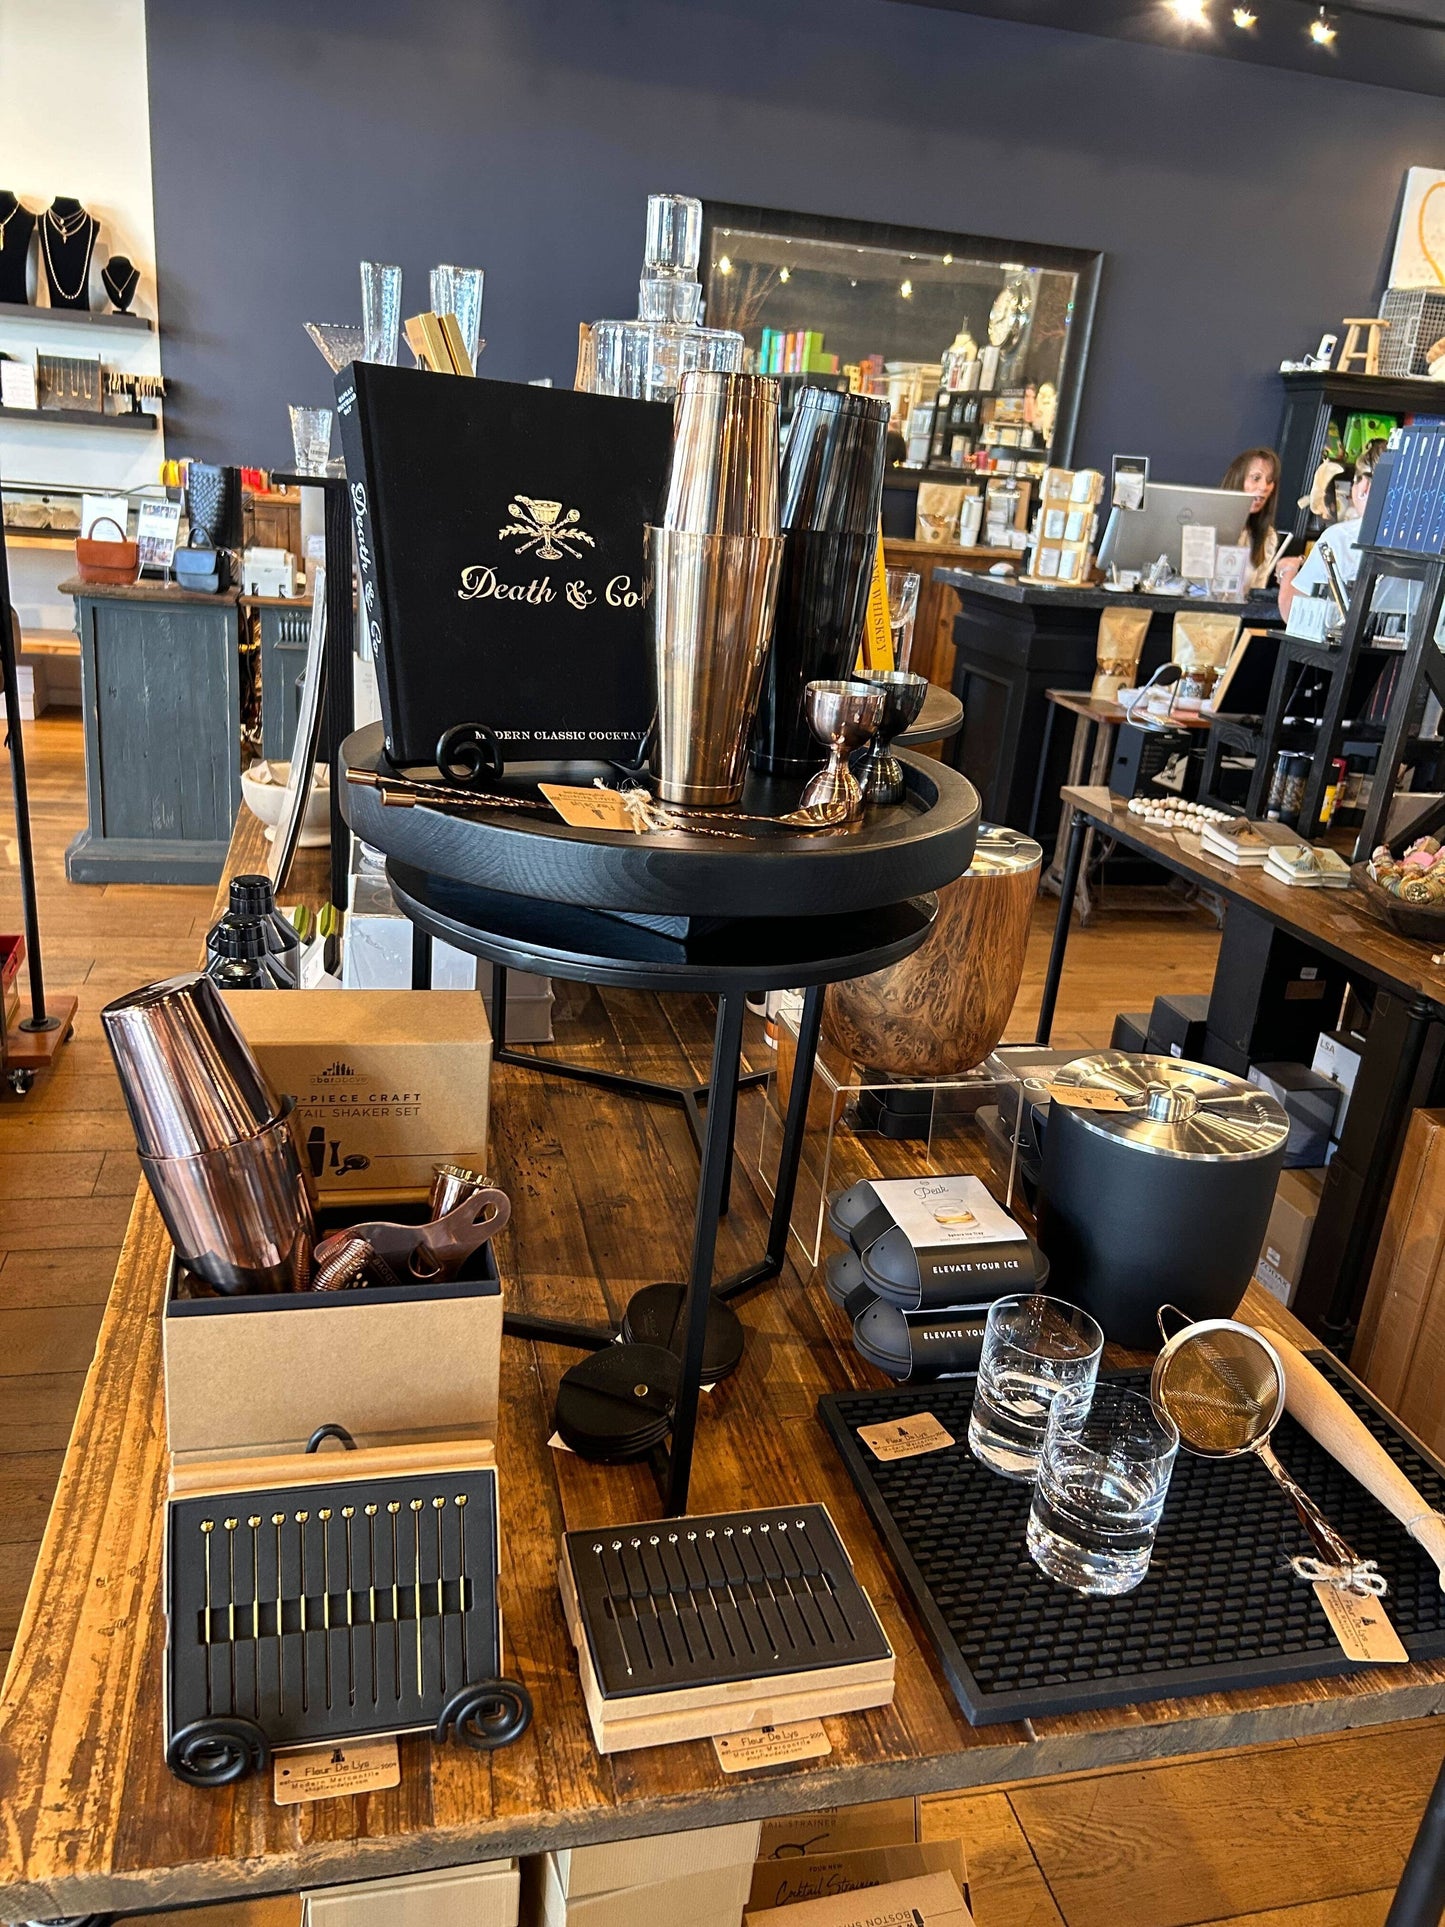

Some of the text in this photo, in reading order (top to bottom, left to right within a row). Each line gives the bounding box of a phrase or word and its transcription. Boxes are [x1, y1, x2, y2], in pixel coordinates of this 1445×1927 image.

[351, 482, 372, 574] Death
[365, 580, 375, 612] &
[457, 565, 557, 605] Death
[566, 580, 597, 610] &
[872, 588, 886, 653] WHISKEY
[475, 730, 530, 740] MDERN
[534, 730, 586, 740] CLASSIC
[290, 1093, 421, 1103] R-PIECE CRAFT
[298, 1106, 420, 1118] TAIL SHAKER SET
[914, 1184, 950, 1200] Peak
[932, 1260, 1018, 1274] ELEVATE YOUR ICE
[923, 1330, 963, 1340] ELEVATE
[966, 1329, 985, 1337] YOU
[741, 1730, 798, 1746] Fleur De Lys
[305, 1760, 370, 1777] Fleur De Lys
[292, 1772, 380, 1790] Modern Mercantile
[762, 1821, 784, 1829] TAIL
[866, 1910, 911, 1926] BOSTON
